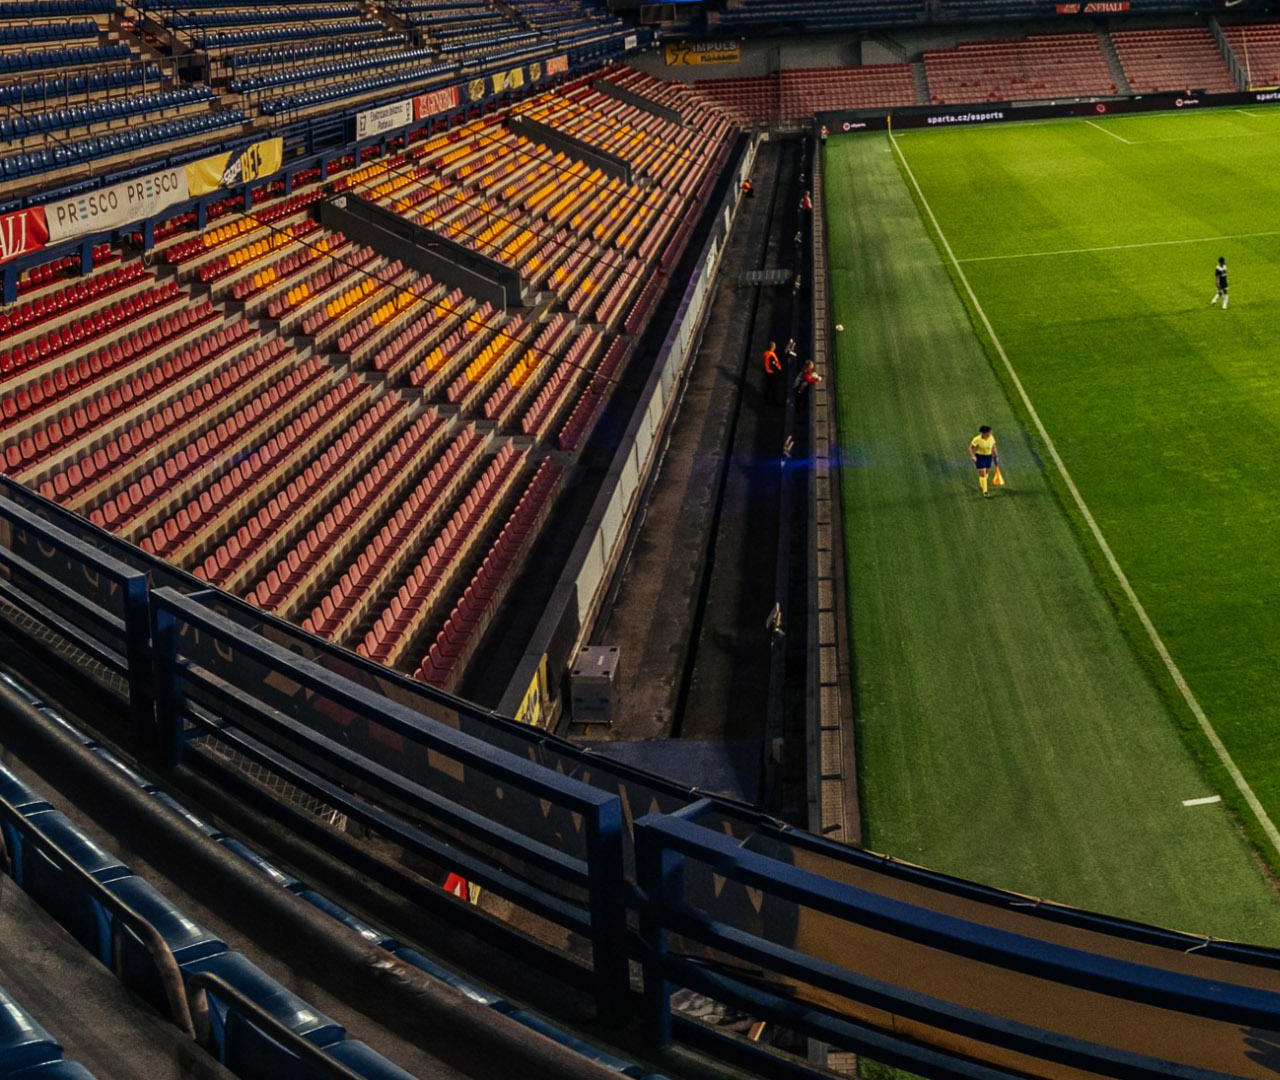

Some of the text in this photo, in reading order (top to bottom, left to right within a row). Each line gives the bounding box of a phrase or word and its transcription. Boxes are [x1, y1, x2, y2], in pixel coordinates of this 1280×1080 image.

[692, 41, 737, 52] IMPULS
[927, 111, 1004, 125] sparta.cz/esports
[57, 172, 178, 226] PRESCO PRESCO
